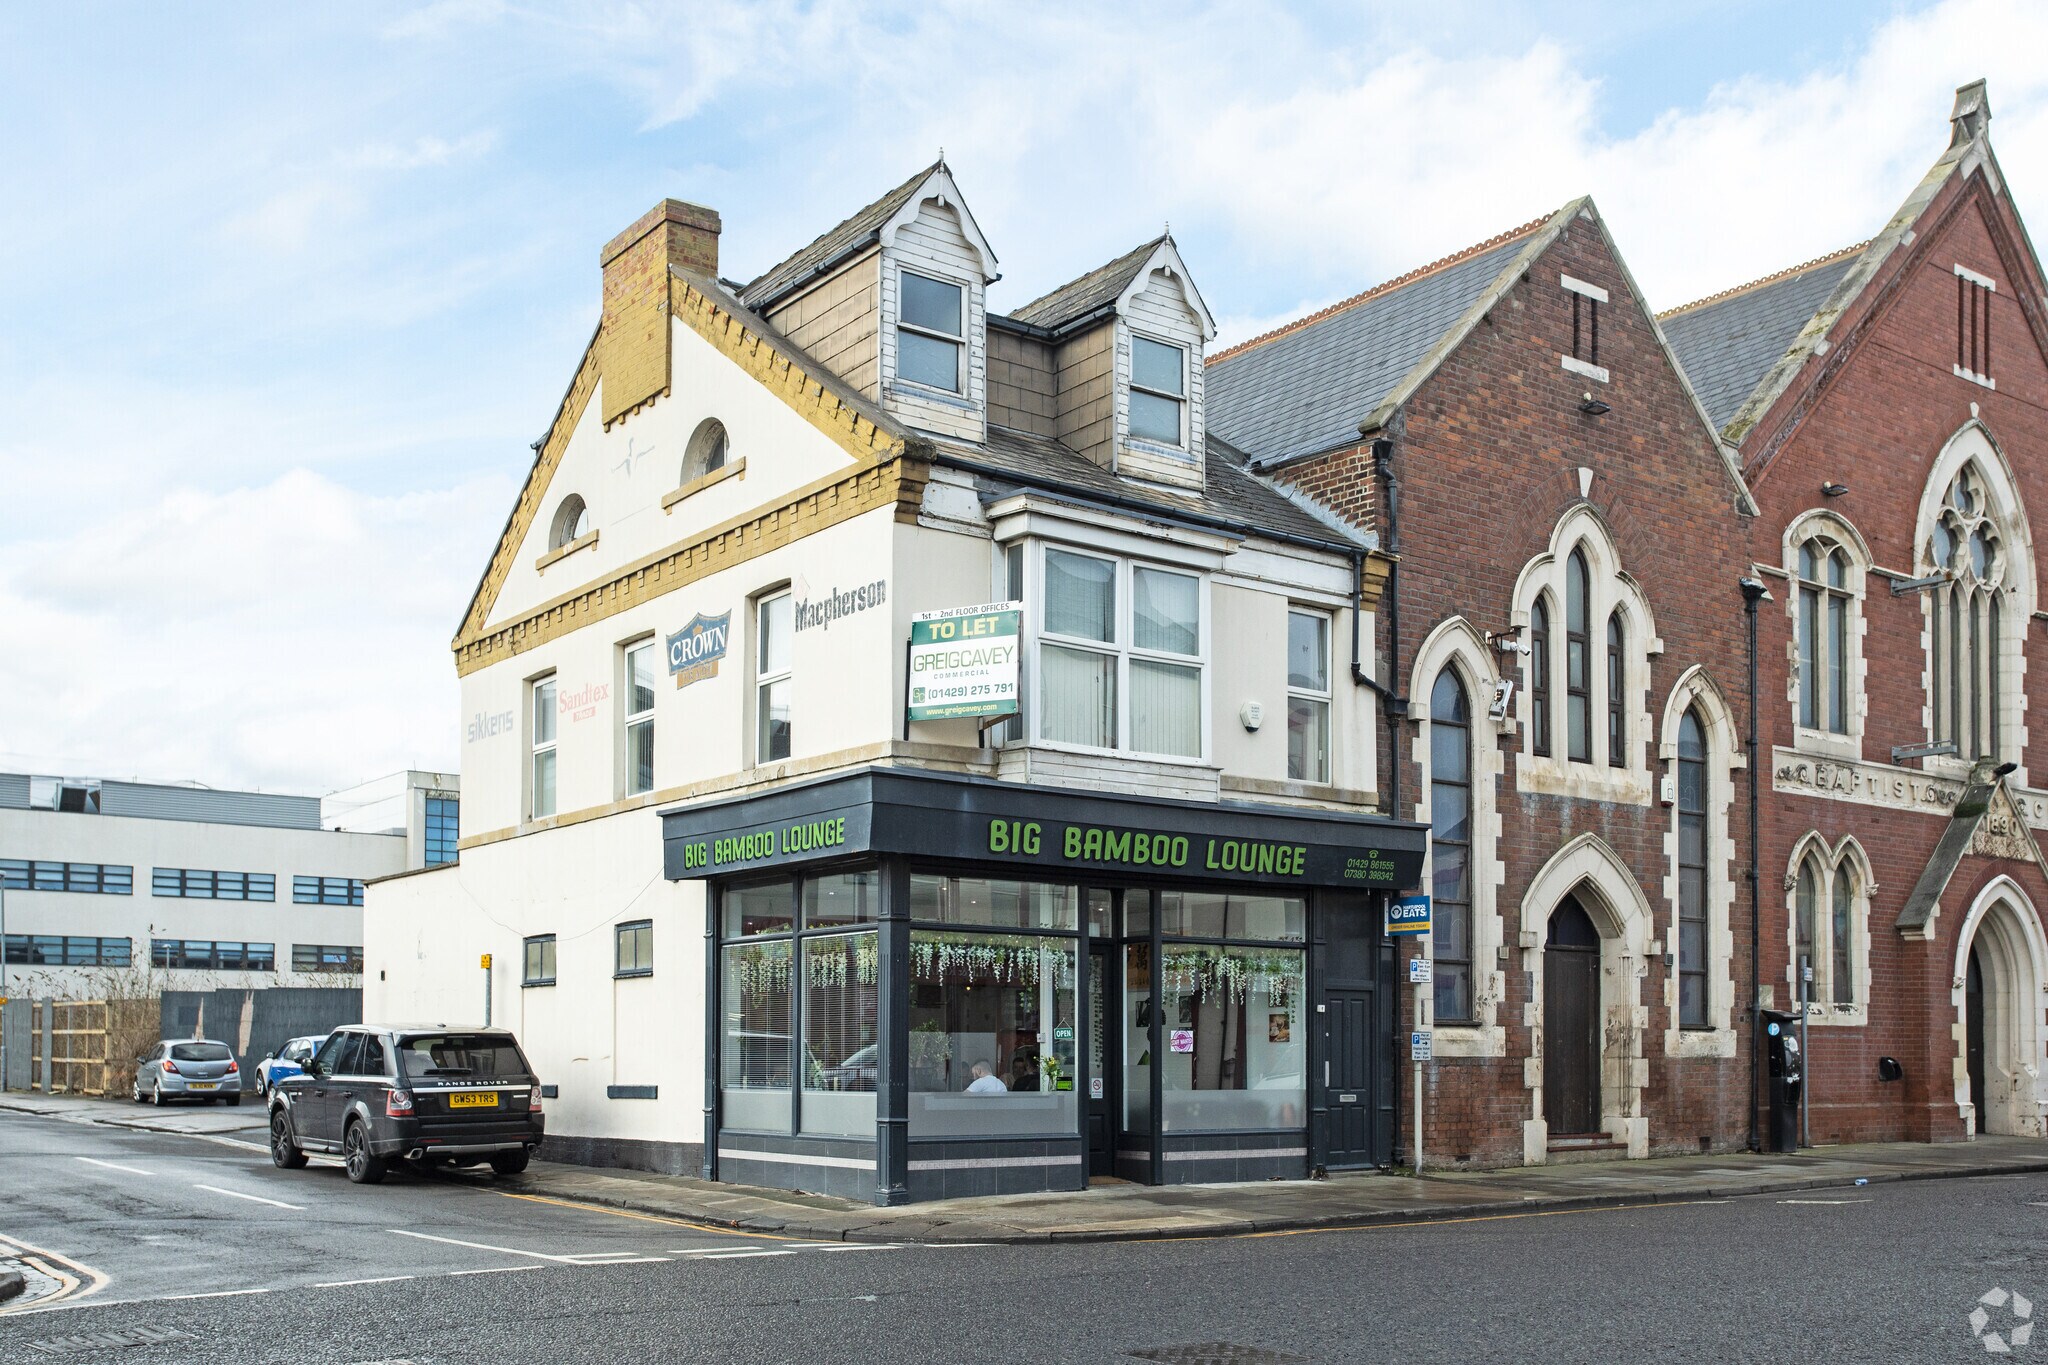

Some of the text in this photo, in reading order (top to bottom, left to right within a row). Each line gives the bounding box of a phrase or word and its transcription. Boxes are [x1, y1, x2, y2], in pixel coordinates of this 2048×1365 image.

[795, 579, 886, 632] Macpherson
[940, 609, 953, 618] 2nd
[955, 606, 978, 616] FLOOR
[981, 602, 1010, 613] OFFICES
[929, 616, 999, 640] TO LET
[671, 624, 726, 665] CROWN
[913, 645, 1014, 672] GREIGCAVEY
[934, 669, 990, 680] COMMERCIAL
[560, 682, 609, 714] Sandtex
[928, 682, 1013, 700] (01429) 275 791
[926, 703, 998, 716] www.greigcavey.com
[468, 710, 513, 743] sikkens
[1987, 814, 2019, 837] 1890
[685, 817, 845, 868] BIG BAMBOO LOUNGE
[989, 819, 1307, 875] BIG BAMBOO LOUNGE
[1344, 869, 1394, 881] 07380 398342
[1347, 858, 1395, 870] 01429 861555
[1402, 908, 1426, 918] EATS
[454, 1095, 494, 1103] GW53 TRS
